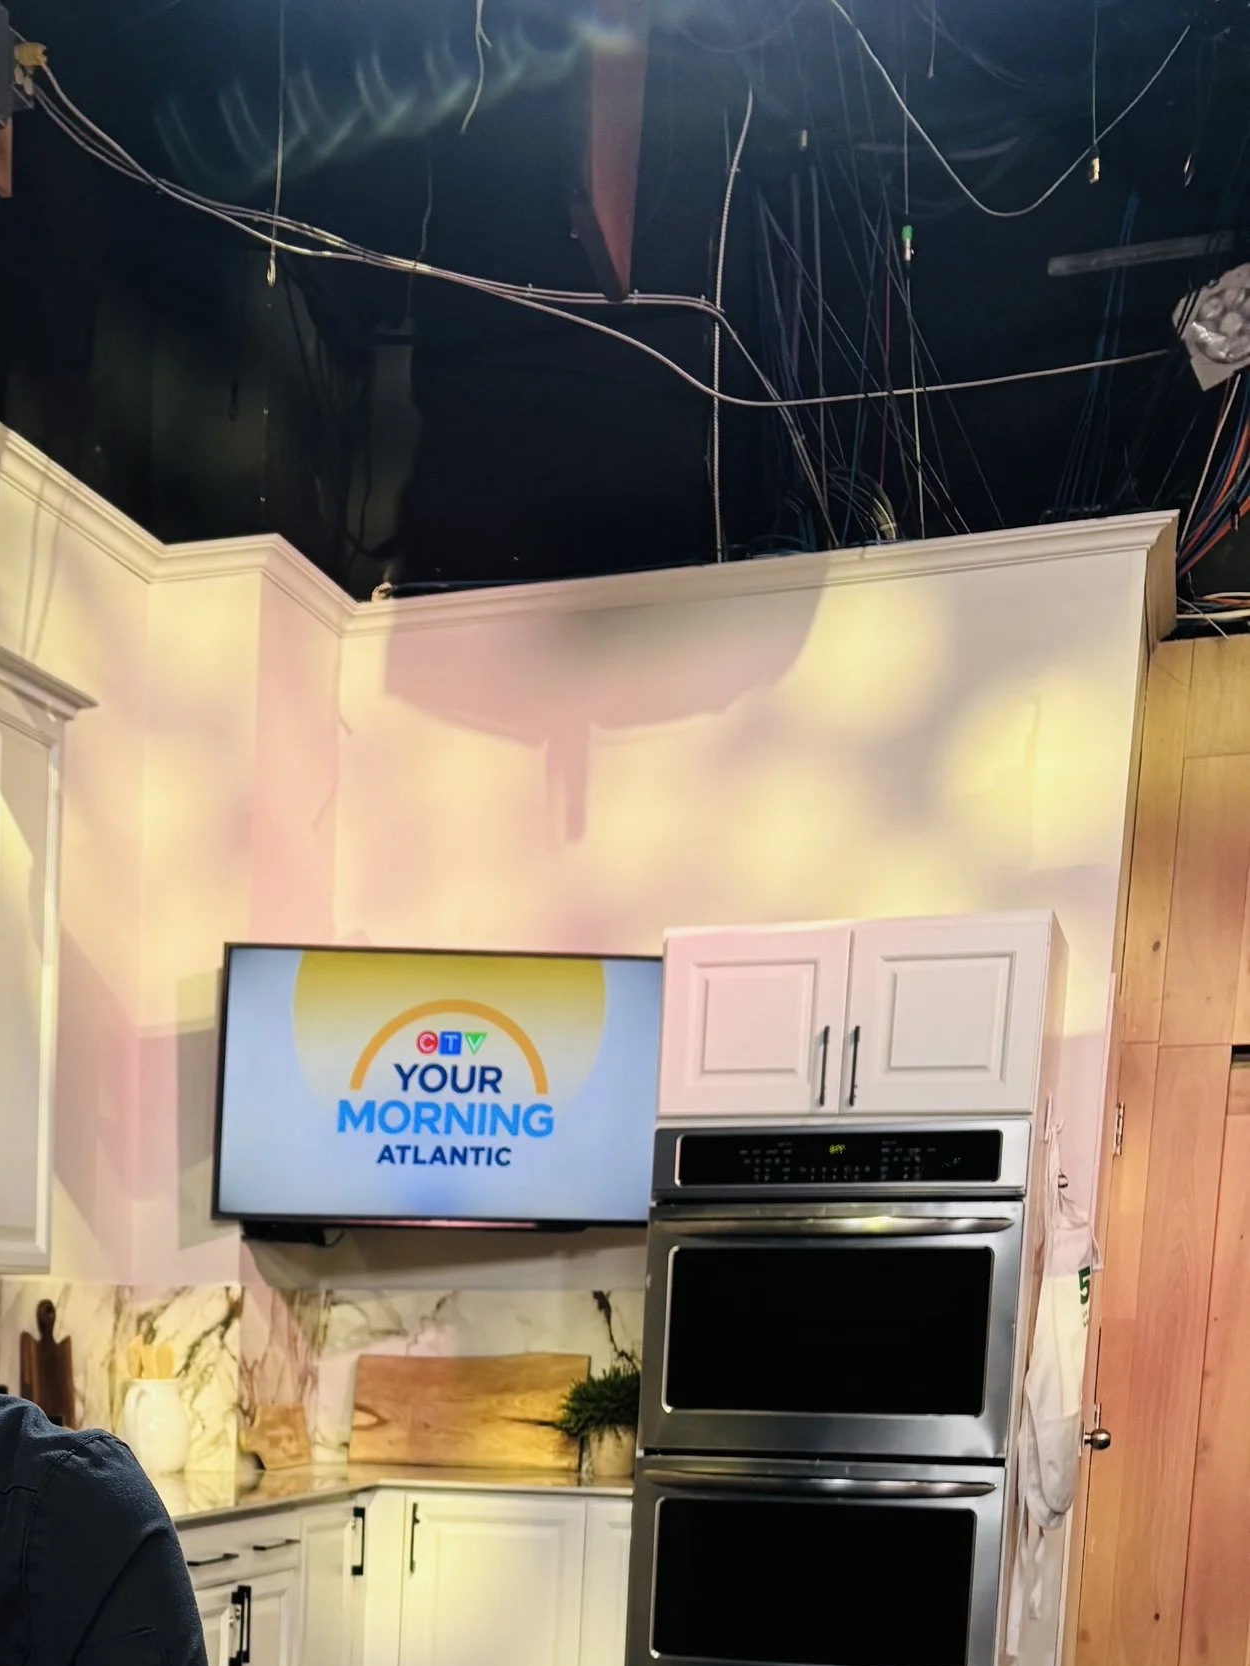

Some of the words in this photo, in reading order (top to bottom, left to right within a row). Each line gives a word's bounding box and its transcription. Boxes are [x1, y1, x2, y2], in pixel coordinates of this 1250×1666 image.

[416, 1030, 488, 1055] CTV
[394, 1063, 503, 1094] YOUR
[337, 1099, 554, 1138] MORNING
[377, 1144, 512, 1167] ATLANTIC
